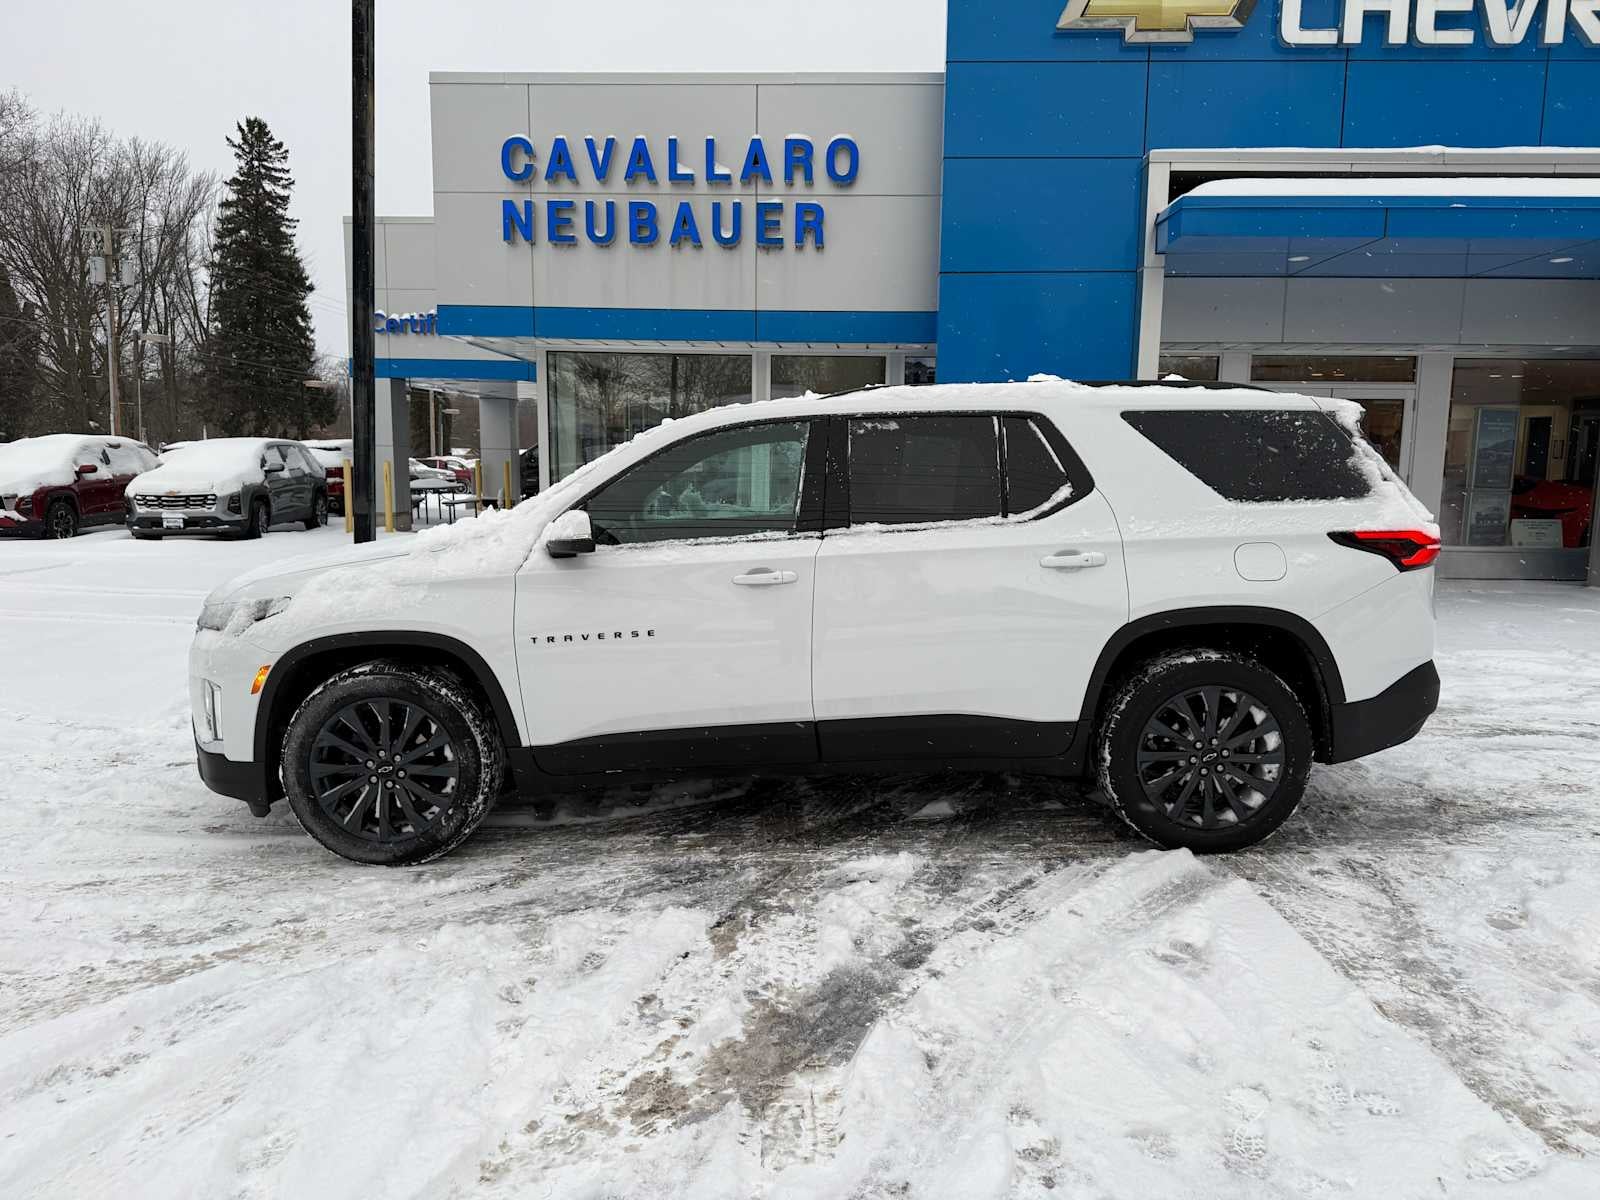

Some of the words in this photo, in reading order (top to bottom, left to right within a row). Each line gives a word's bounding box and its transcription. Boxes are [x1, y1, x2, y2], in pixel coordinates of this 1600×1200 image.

[500, 134, 860, 187] CAVALLARO
[502, 199, 826, 249] NEUBAUER
[374, 310, 439, 335] Certif
[530, 629, 656, 645] TRAVERSE
